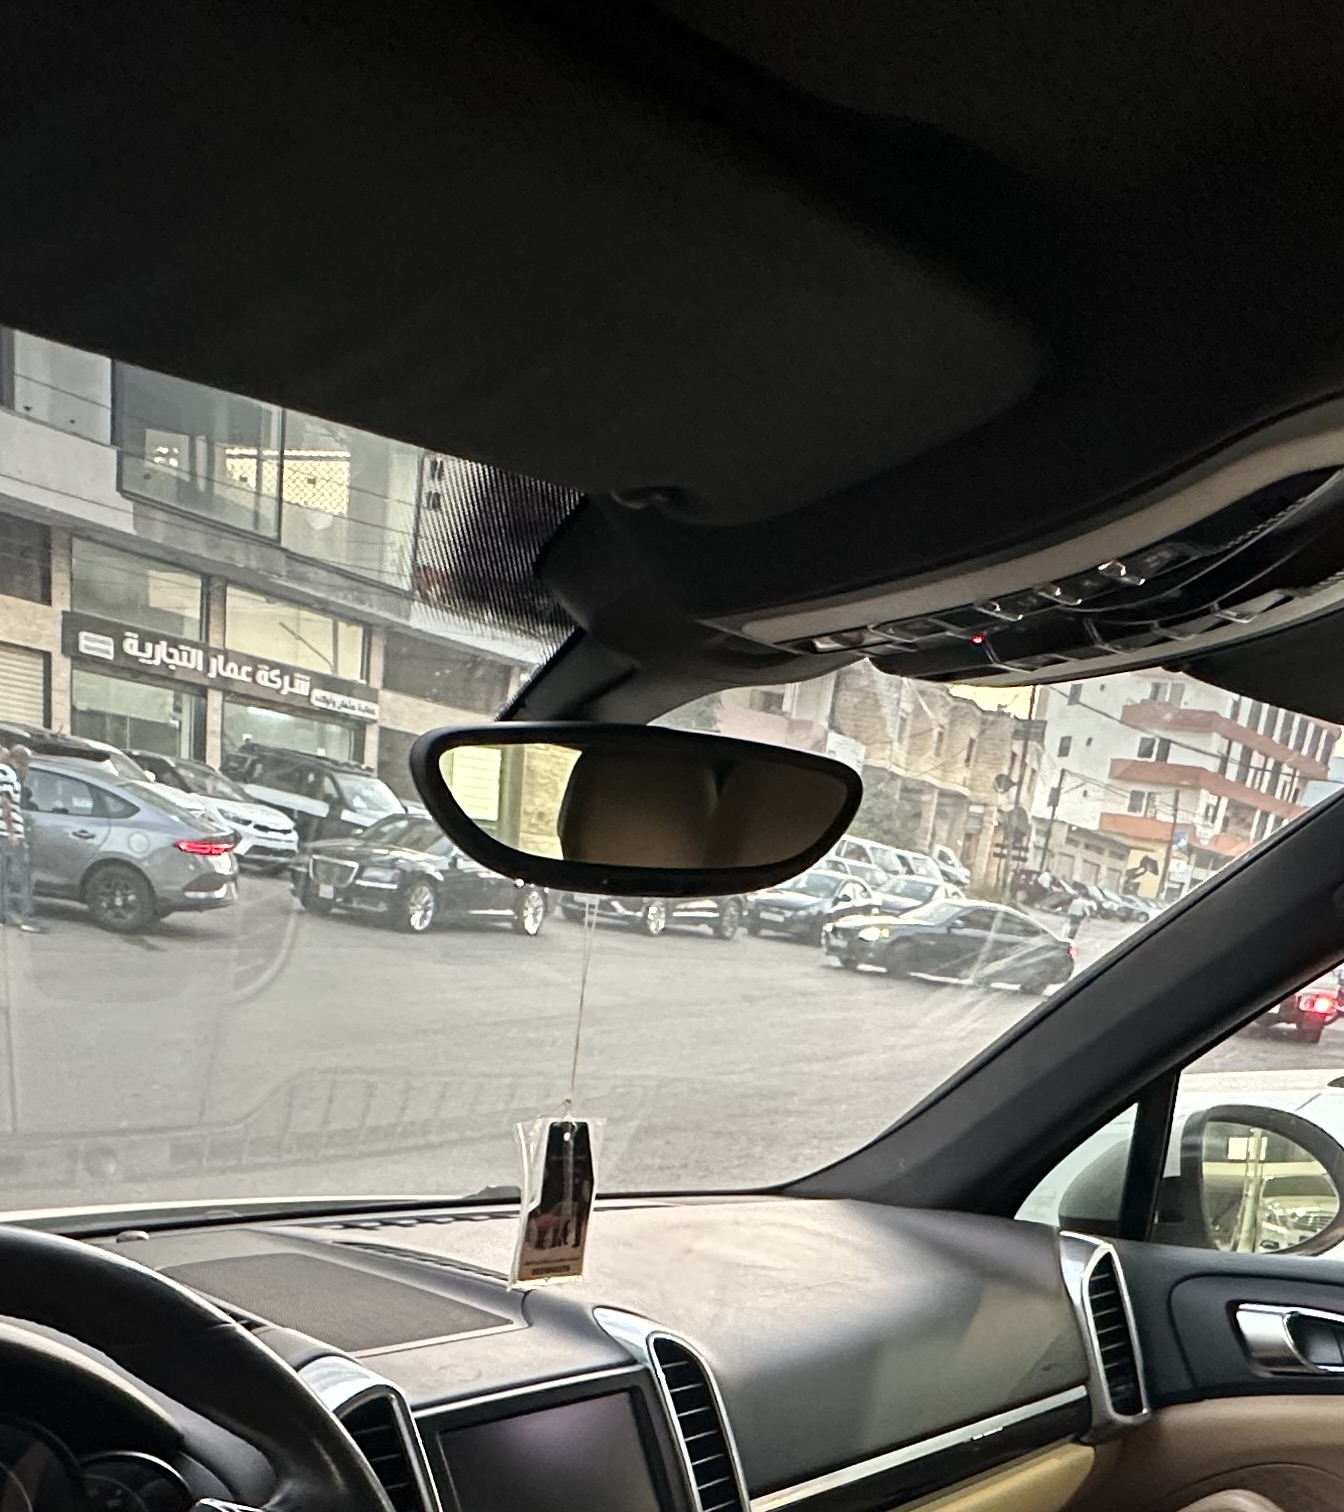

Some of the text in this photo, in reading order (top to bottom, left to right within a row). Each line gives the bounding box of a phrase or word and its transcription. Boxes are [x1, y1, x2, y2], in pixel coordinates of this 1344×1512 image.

[122, 631, 311, 697] شركة عمار التجارية
